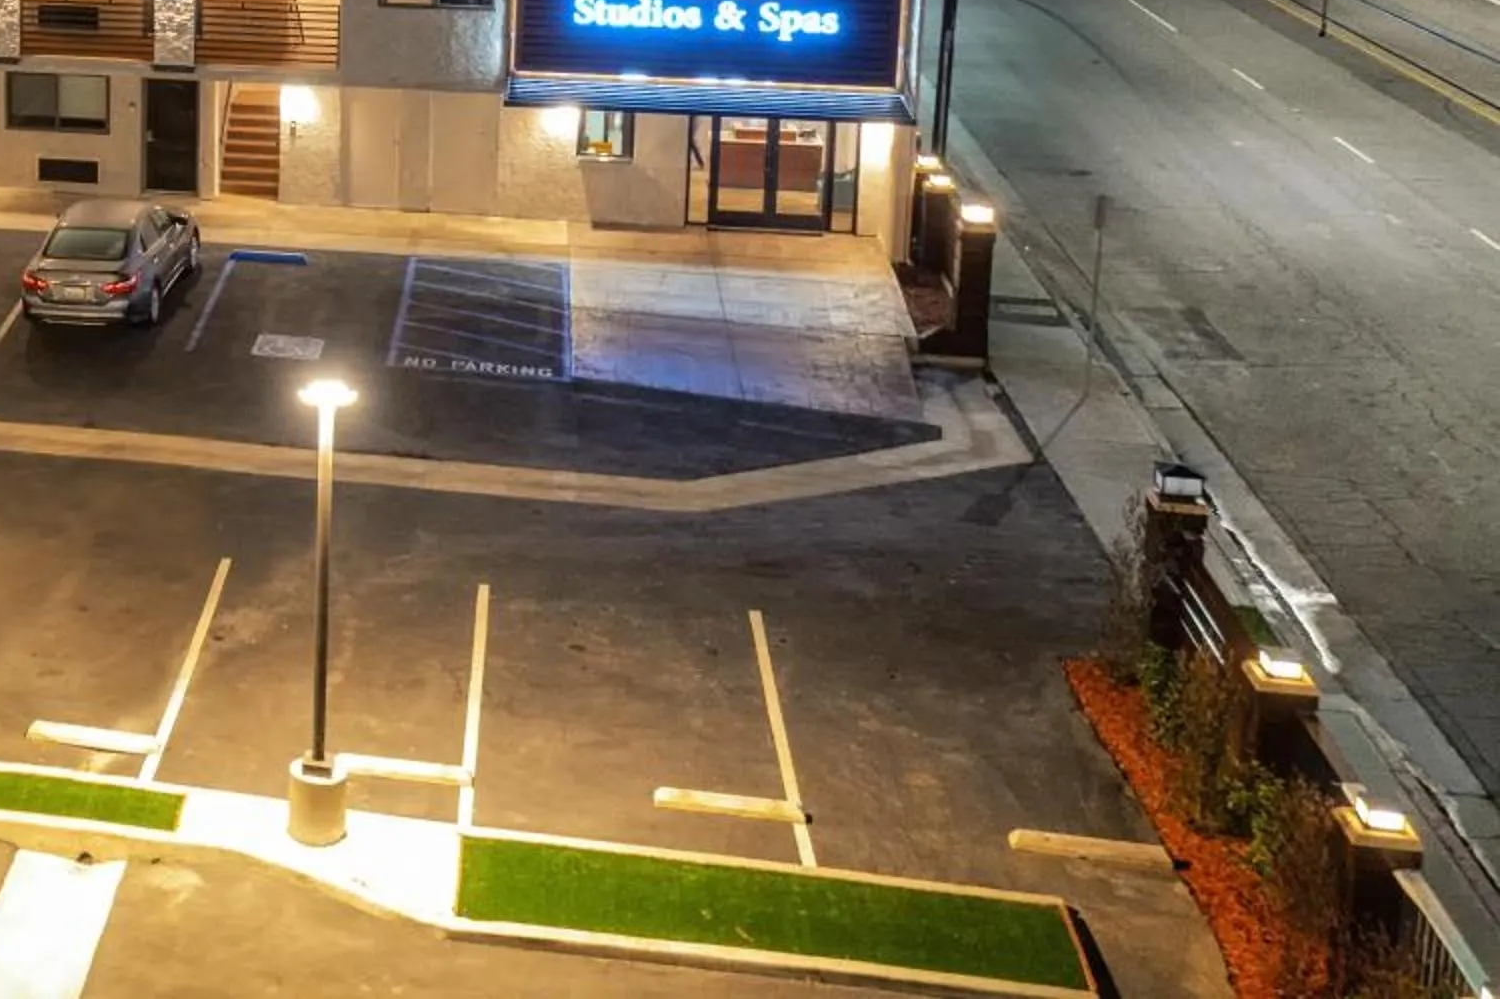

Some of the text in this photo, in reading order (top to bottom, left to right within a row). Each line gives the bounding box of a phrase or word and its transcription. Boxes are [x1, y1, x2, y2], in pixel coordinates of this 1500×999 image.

[714, 0, 745, 31] &
[758, 2, 838, 41] Spas
[403, 356, 553, 378] NO PARKING
